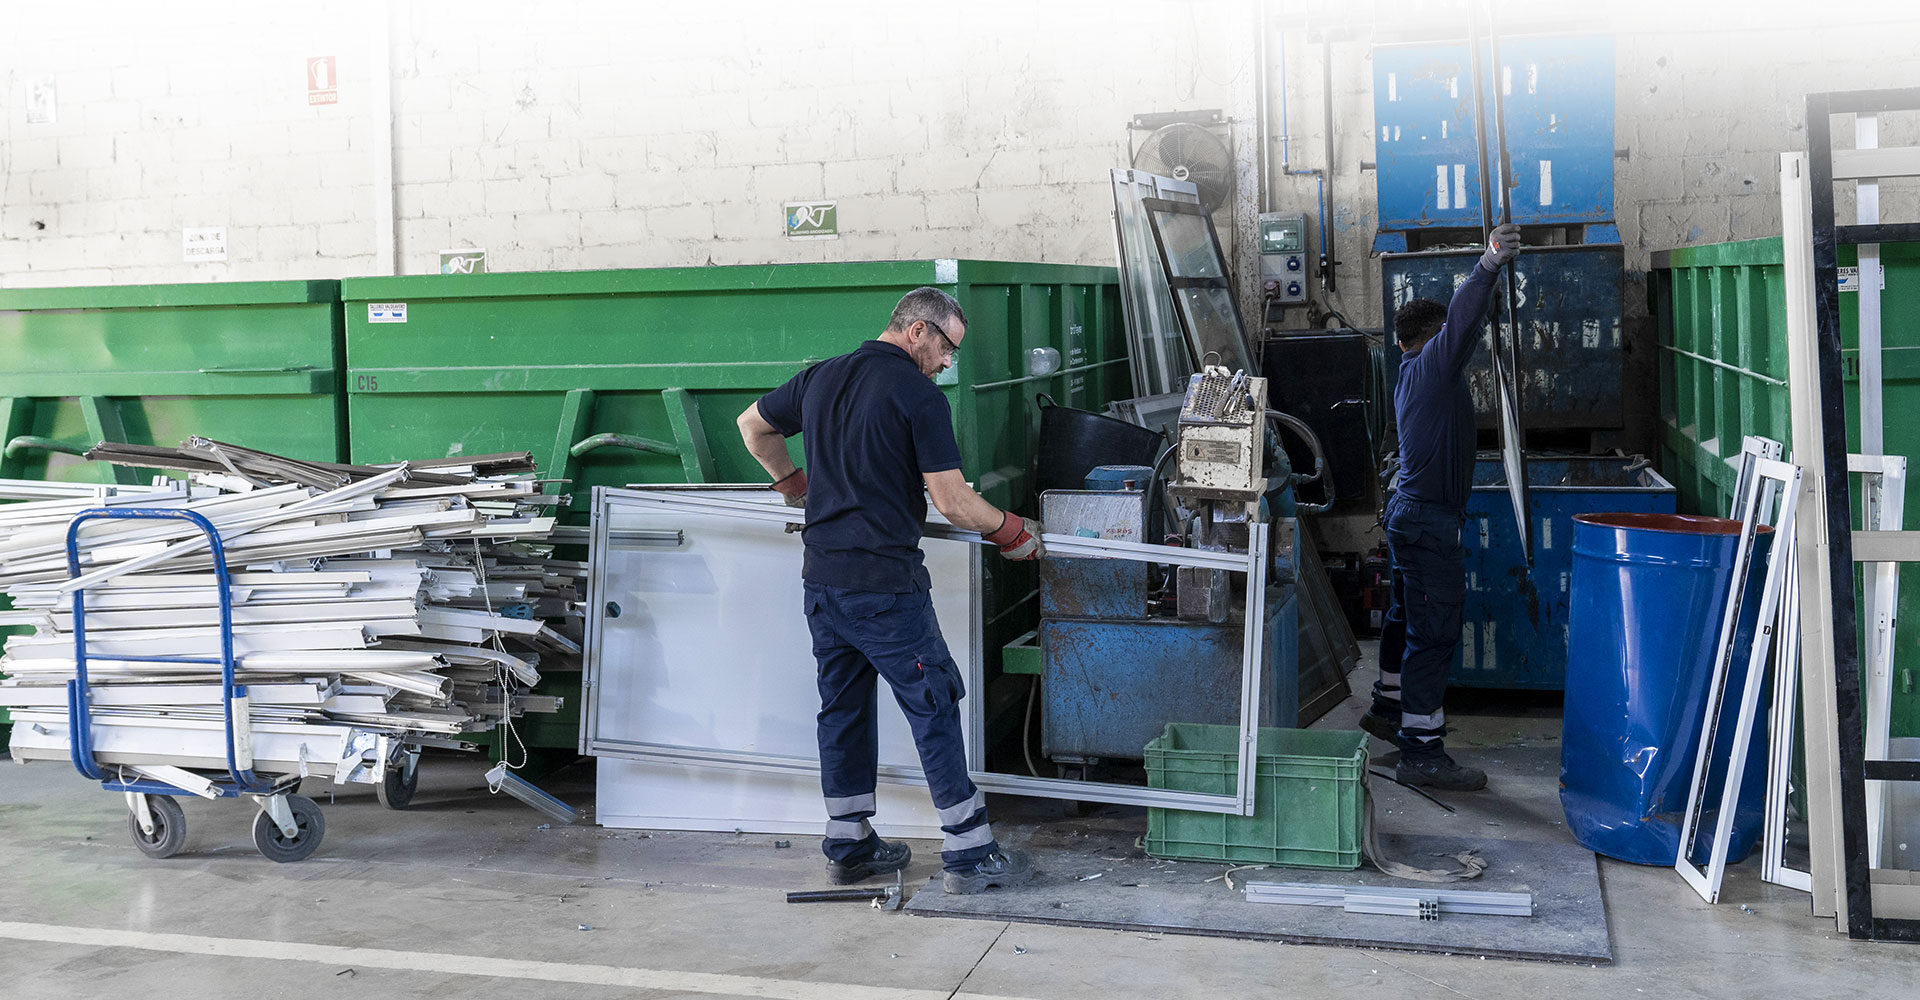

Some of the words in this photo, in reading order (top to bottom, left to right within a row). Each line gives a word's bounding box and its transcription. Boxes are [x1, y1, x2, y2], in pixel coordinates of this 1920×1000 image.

[309, 93, 336, 103] EXTINTOR
[210, 232, 221, 241] DE
[186, 246, 225, 255] DESCARGA
[358, 375, 378, 391] C15
